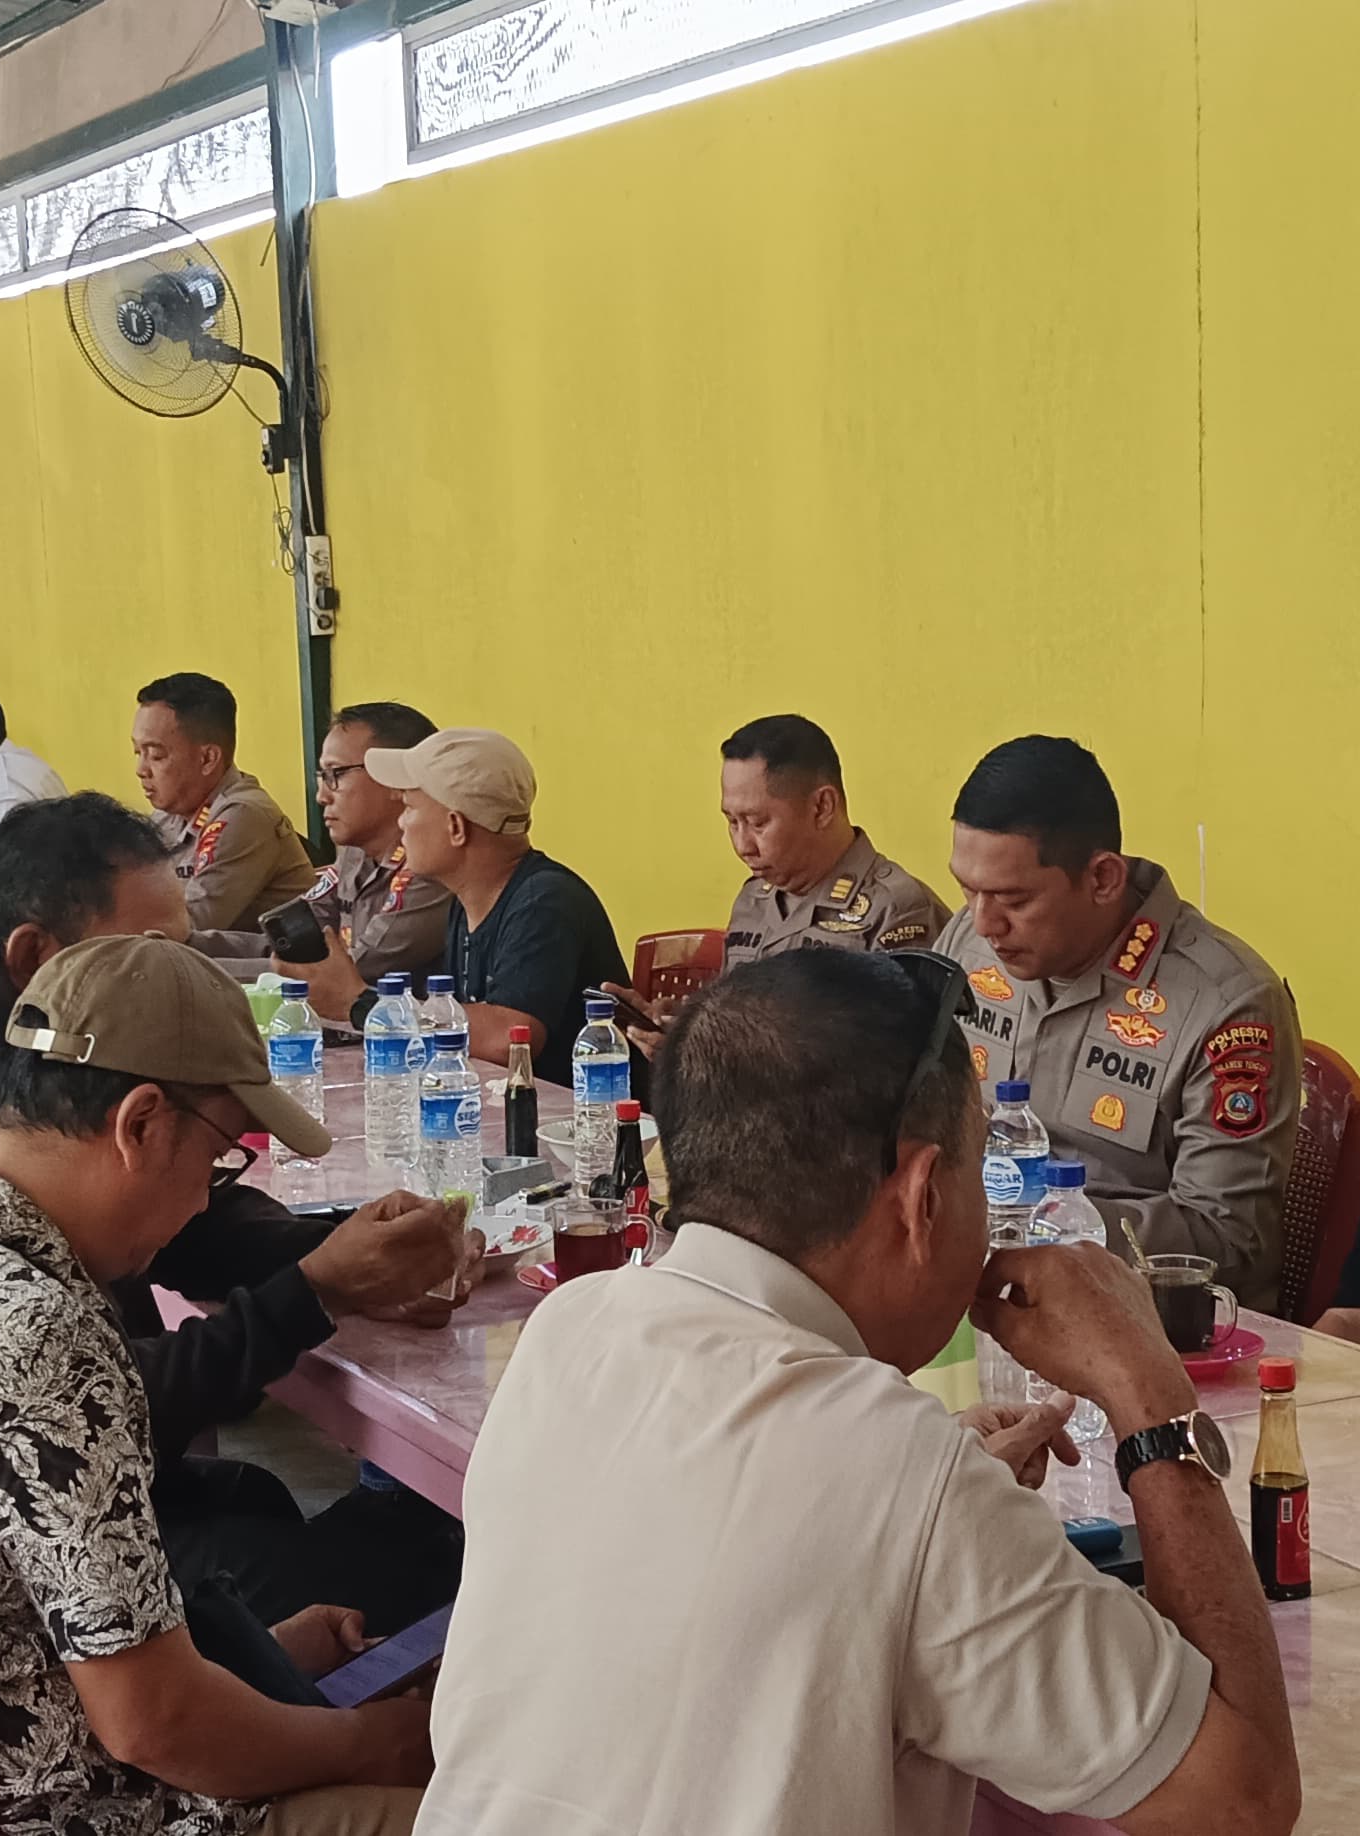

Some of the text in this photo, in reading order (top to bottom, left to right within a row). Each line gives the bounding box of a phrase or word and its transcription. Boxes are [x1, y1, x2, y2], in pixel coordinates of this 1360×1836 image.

[1208, 1026, 1269, 1051] POLRESTA
[1220, 1036, 1261, 1053] PALU
[1086, 1045, 1157, 1090] POLRI
